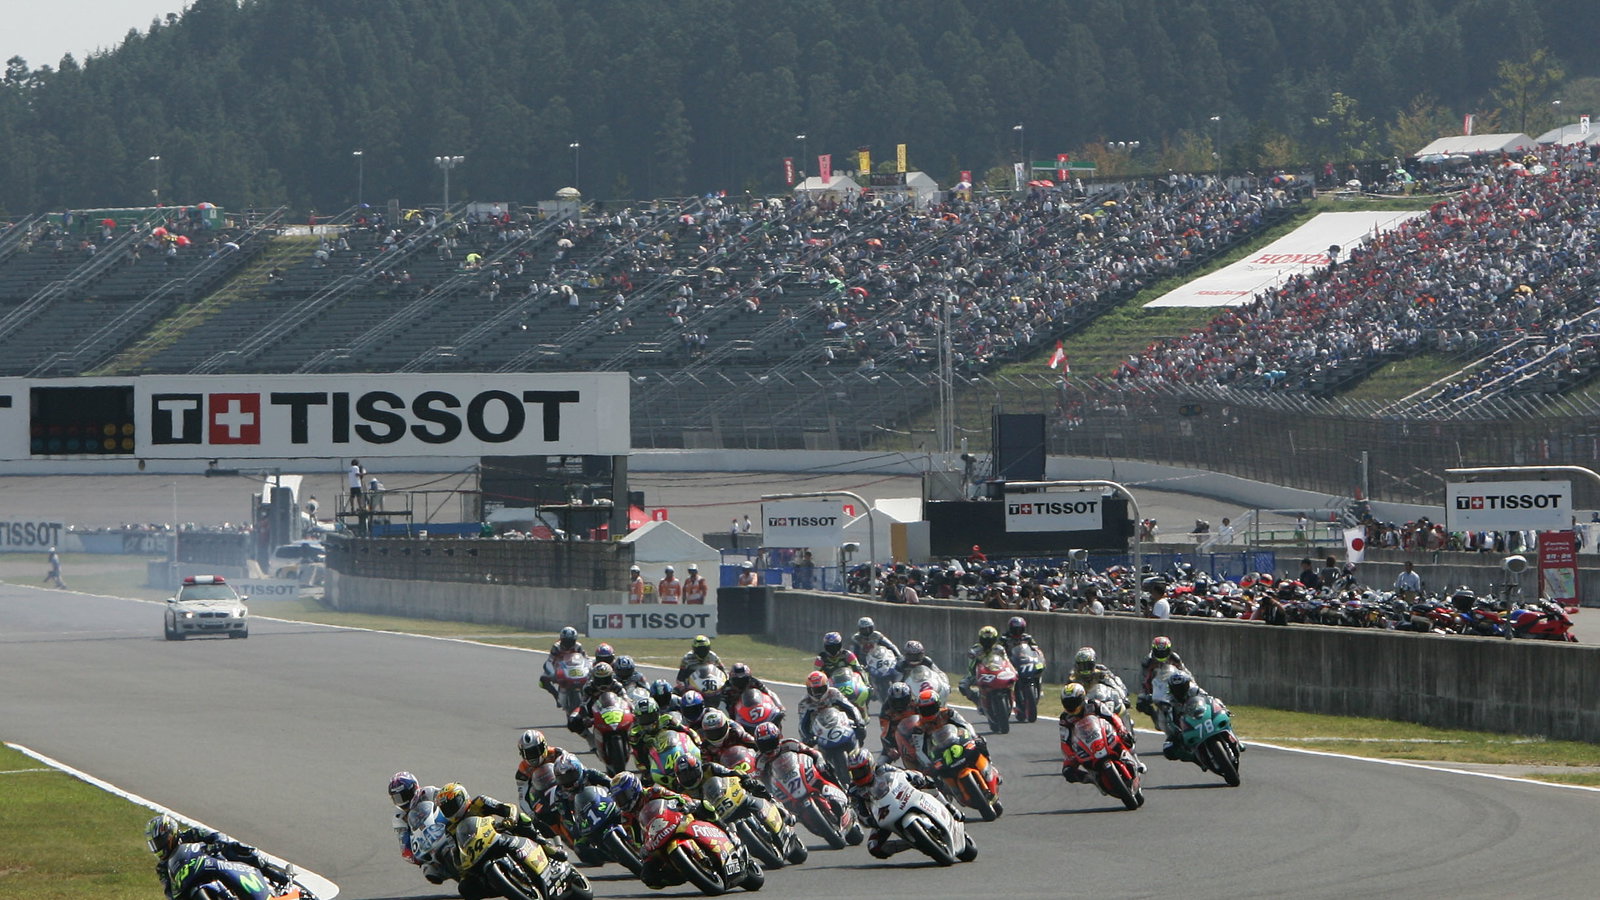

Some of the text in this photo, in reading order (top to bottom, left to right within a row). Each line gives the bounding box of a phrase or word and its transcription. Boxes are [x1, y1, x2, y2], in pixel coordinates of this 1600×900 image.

[270, 389, 580, 445] TISSOT
[1033, 500, 1098, 515] TISSOT
[1485, 494, 1562, 509] TISSOT
[788, 516, 837, 527] TISSOT
[240, 584, 296, 596] TISSOT
[626, 613, 710, 629] TISSOT
[701, 679, 717, 692] 36
[749, 705, 765, 720] 57
[1195, 719, 1214, 738] 78
[587, 808, 602, 826] 1
